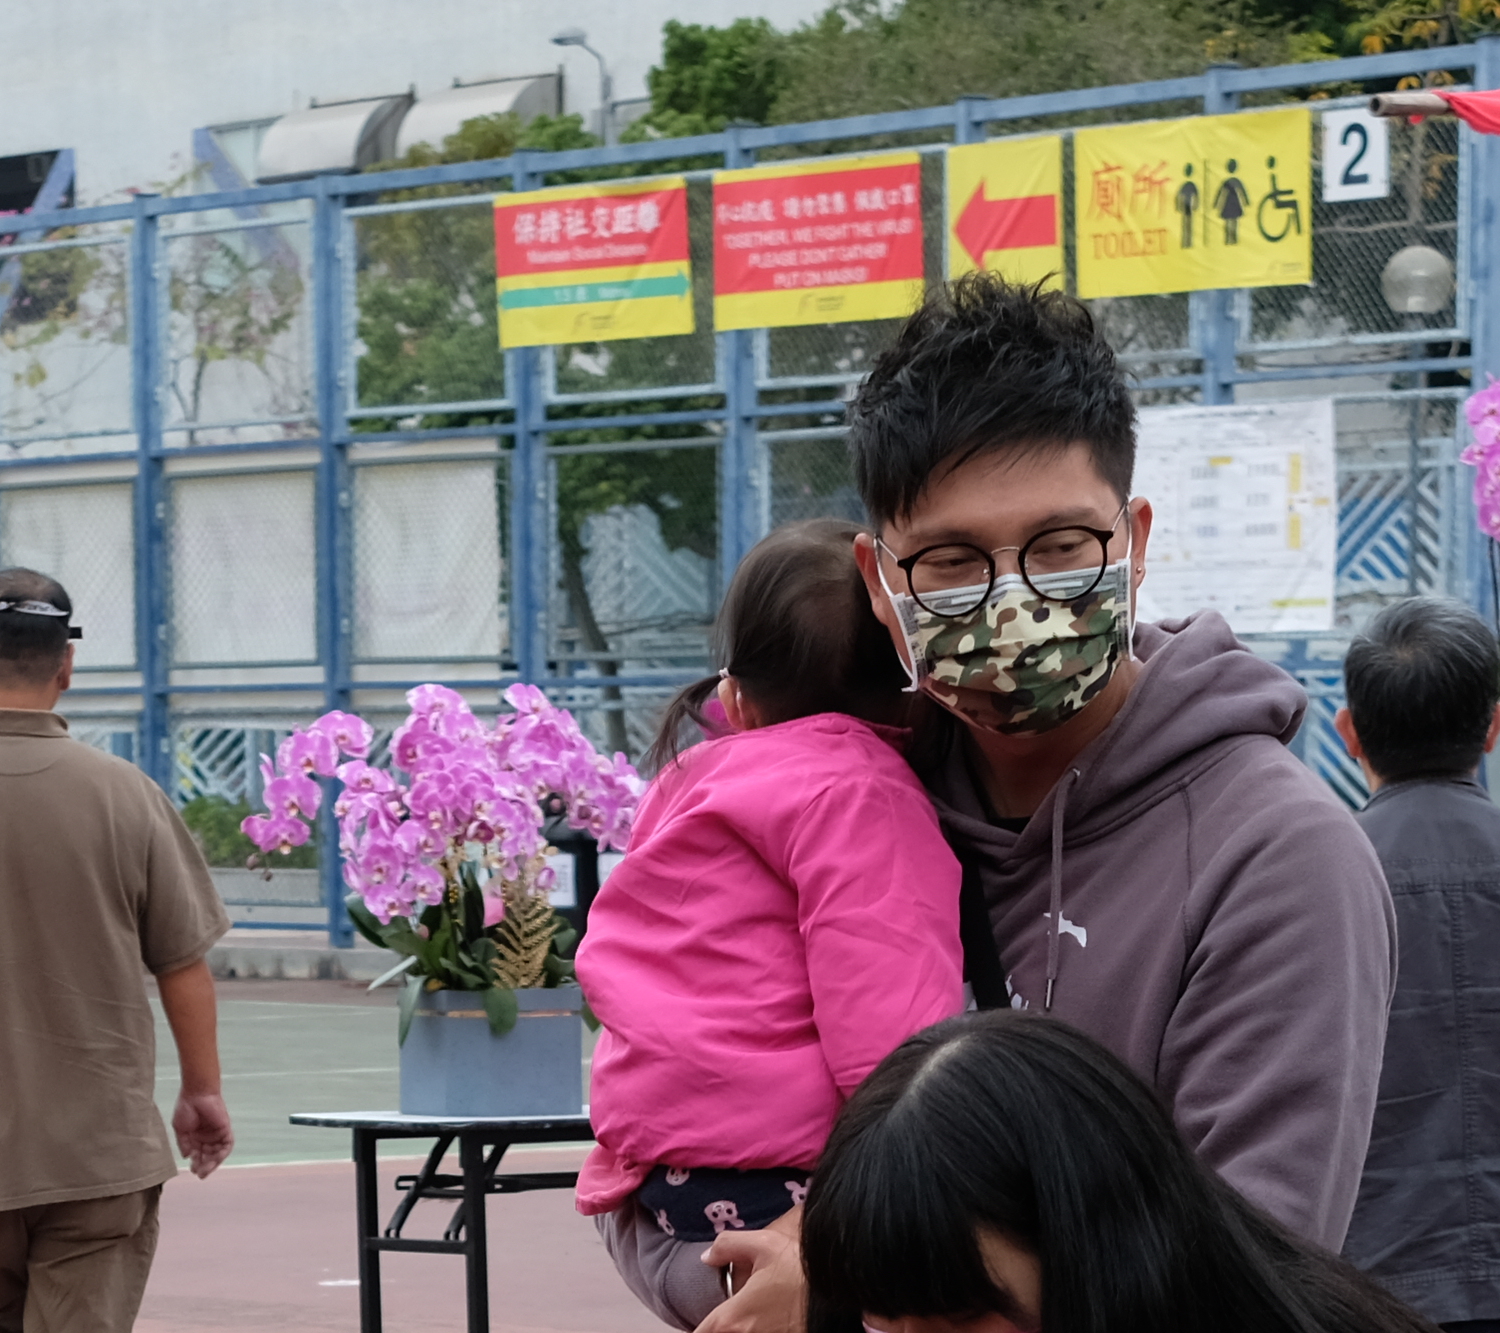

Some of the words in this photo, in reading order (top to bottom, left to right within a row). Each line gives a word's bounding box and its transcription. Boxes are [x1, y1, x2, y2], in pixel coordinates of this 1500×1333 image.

[1340, 122, 1370, 186] 2
[1088, 160, 1172, 222] 廁所
[1091, 228, 1168, 260] TOILET
